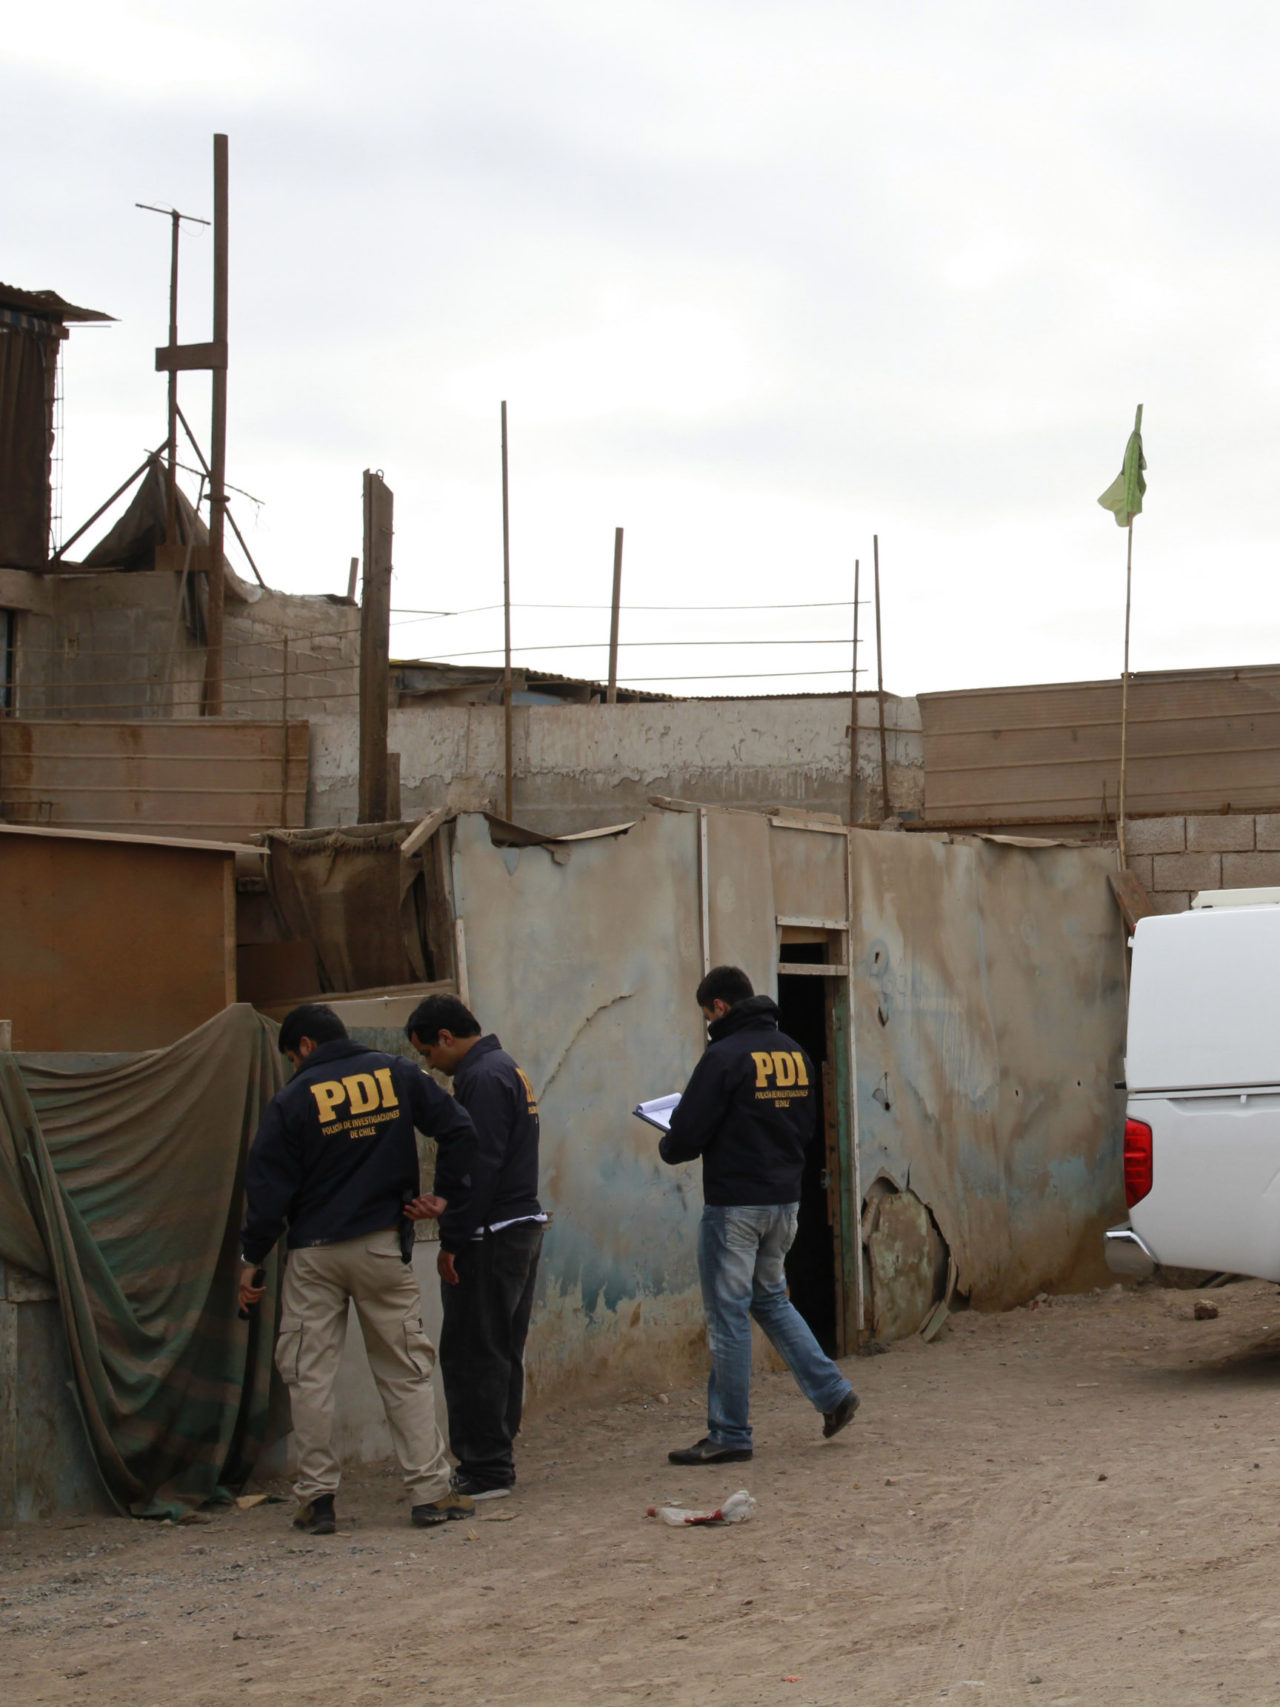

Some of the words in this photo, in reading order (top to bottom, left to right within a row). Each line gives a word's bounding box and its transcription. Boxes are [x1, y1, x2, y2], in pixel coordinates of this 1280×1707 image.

[751, 1051, 809, 1087] PDI
[310, 1067, 399, 1123] PDI
[343, 1120, 352, 1129] DE
[352, 1109, 400, 1127] INVESTIGACIONES
[349, 1129, 359, 1139] DE
[358, 1126, 376, 1137] CHILE
